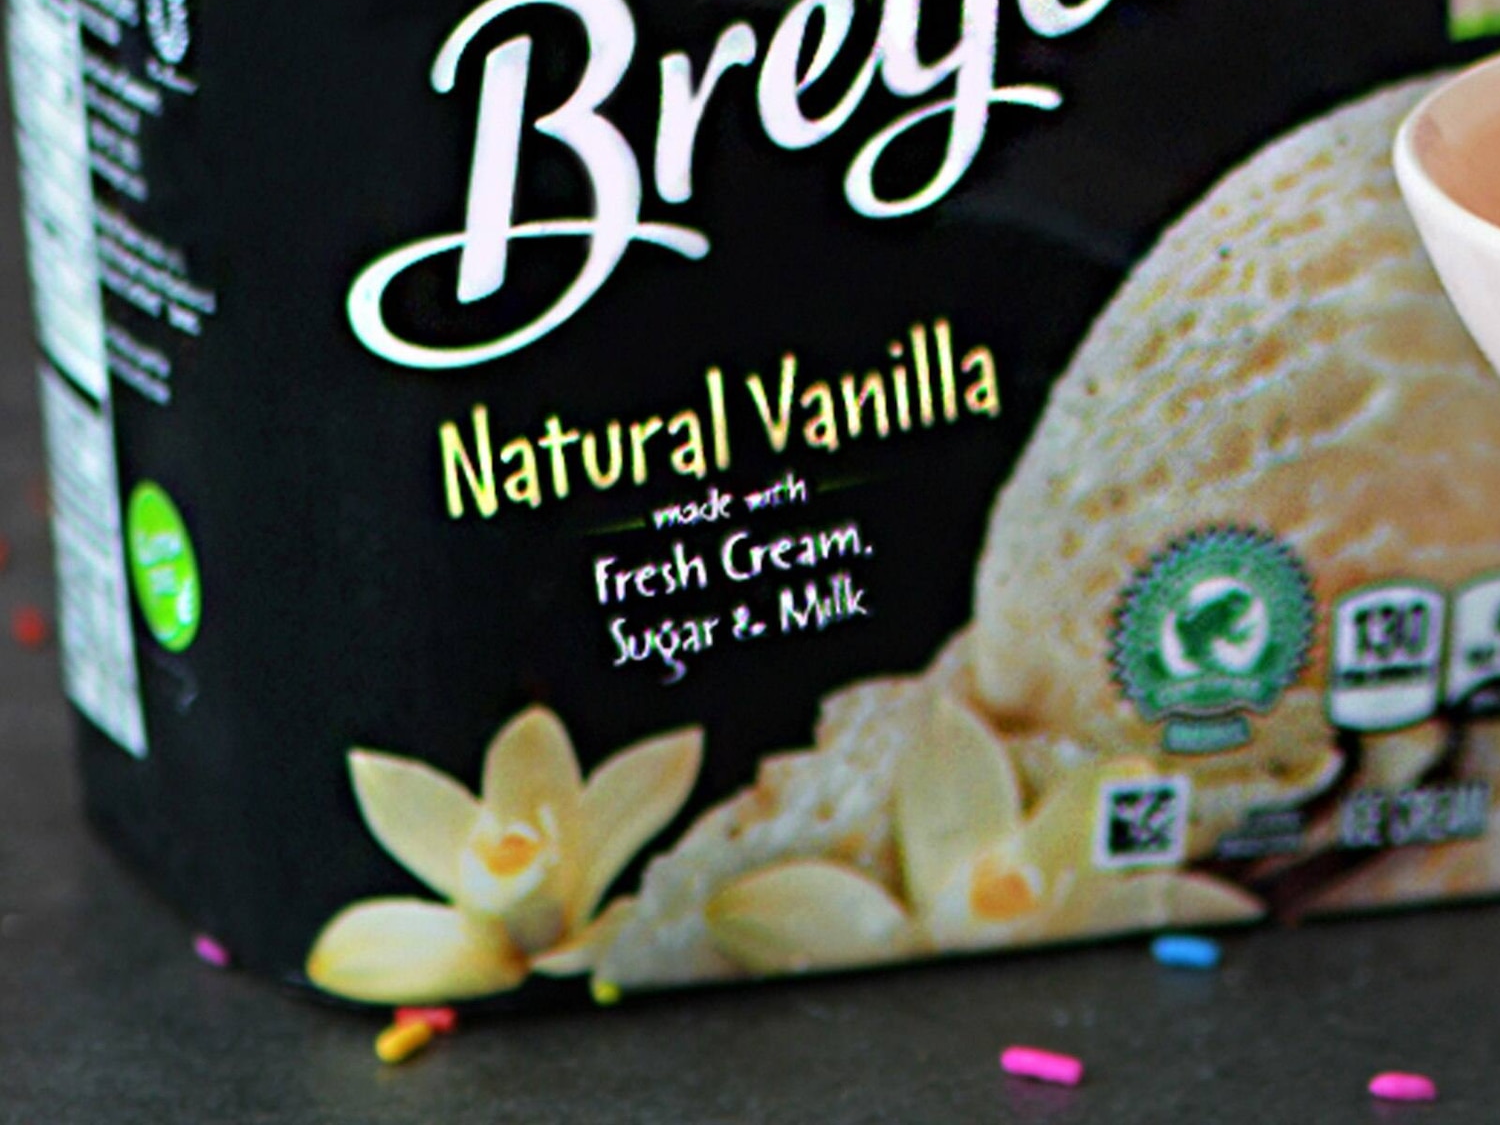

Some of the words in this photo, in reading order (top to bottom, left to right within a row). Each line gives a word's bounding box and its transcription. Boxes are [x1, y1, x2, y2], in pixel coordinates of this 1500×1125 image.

[438, 366, 731, 520] Natural
[746, 317, 1001, 453] Vanilla
[652, 486, 733, 530] made
[743, 472, 808, 512] with
[594, 540, 708, 604] Fresh
[608, 616, 721, 685] Sugar
[731, 603, 767, 640] &
[778, 571, 870, 633] Milk
